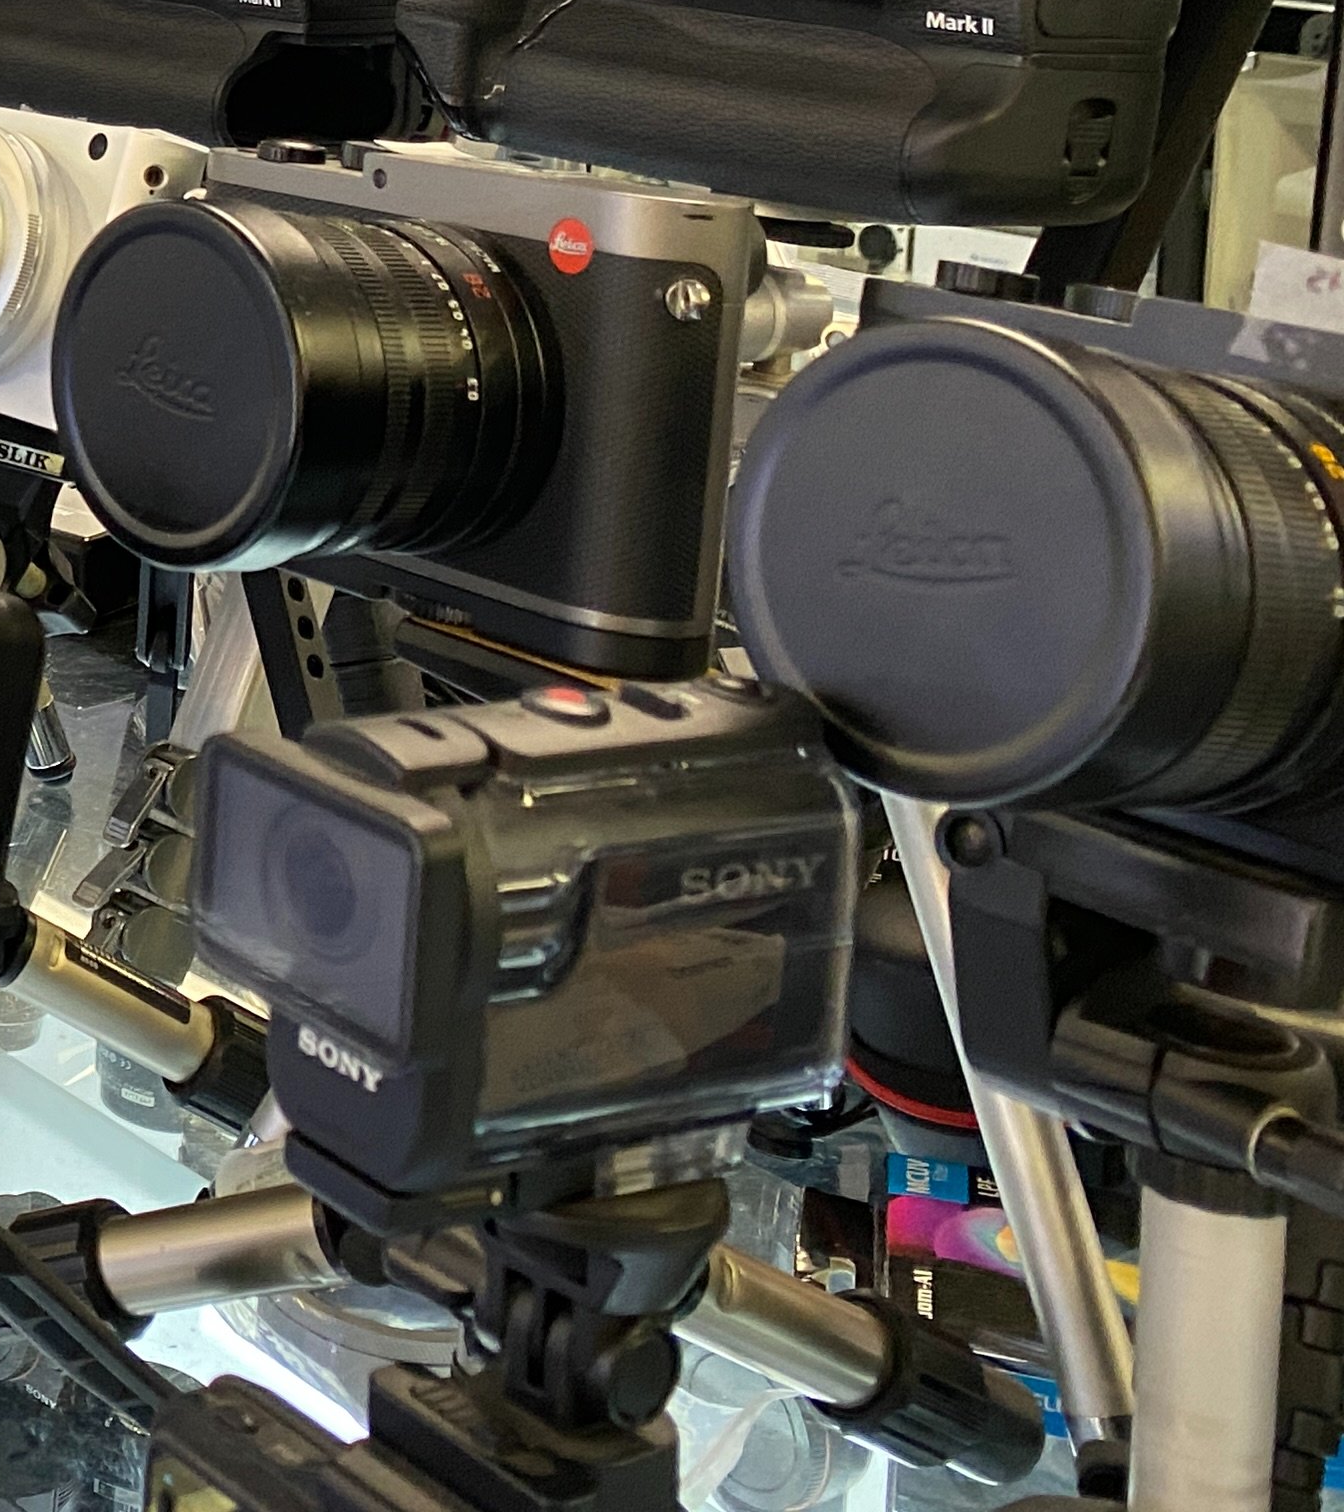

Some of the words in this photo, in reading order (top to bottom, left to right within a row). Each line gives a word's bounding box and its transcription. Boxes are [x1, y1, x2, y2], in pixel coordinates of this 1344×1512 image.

[925, 11, 978, 33] Mark
[981, 16, 995, 35] II
[549, 231, 588, 256] Leica
[679, 854, 826, 895] SONY
[296, 1025, 385, 1092] SONY
